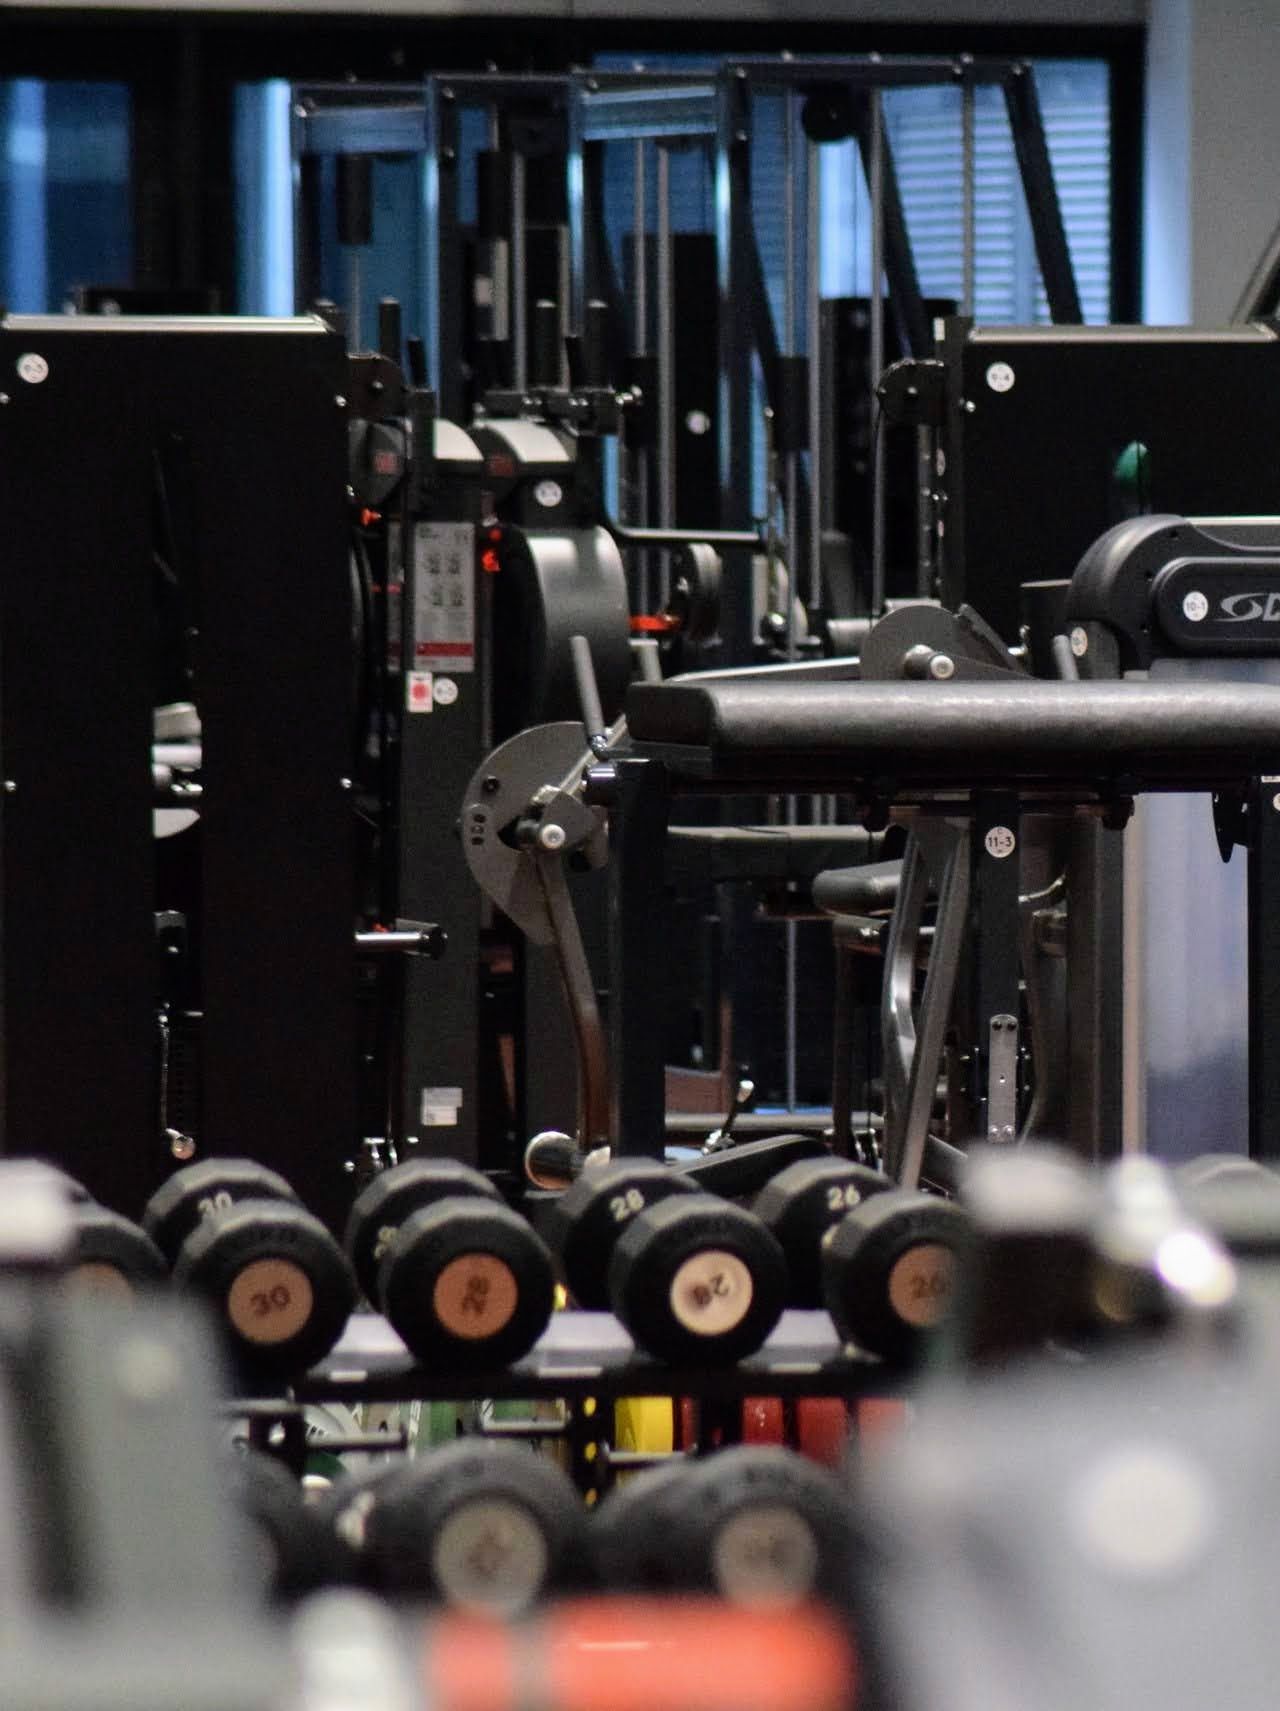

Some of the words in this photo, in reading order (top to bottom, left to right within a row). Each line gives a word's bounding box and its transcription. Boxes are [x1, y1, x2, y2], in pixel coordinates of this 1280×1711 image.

[988, 836, 1013, 847] 11-3
[827, 1184, 861, 1211] 26
[249, 1285, 292, 1316] 30
